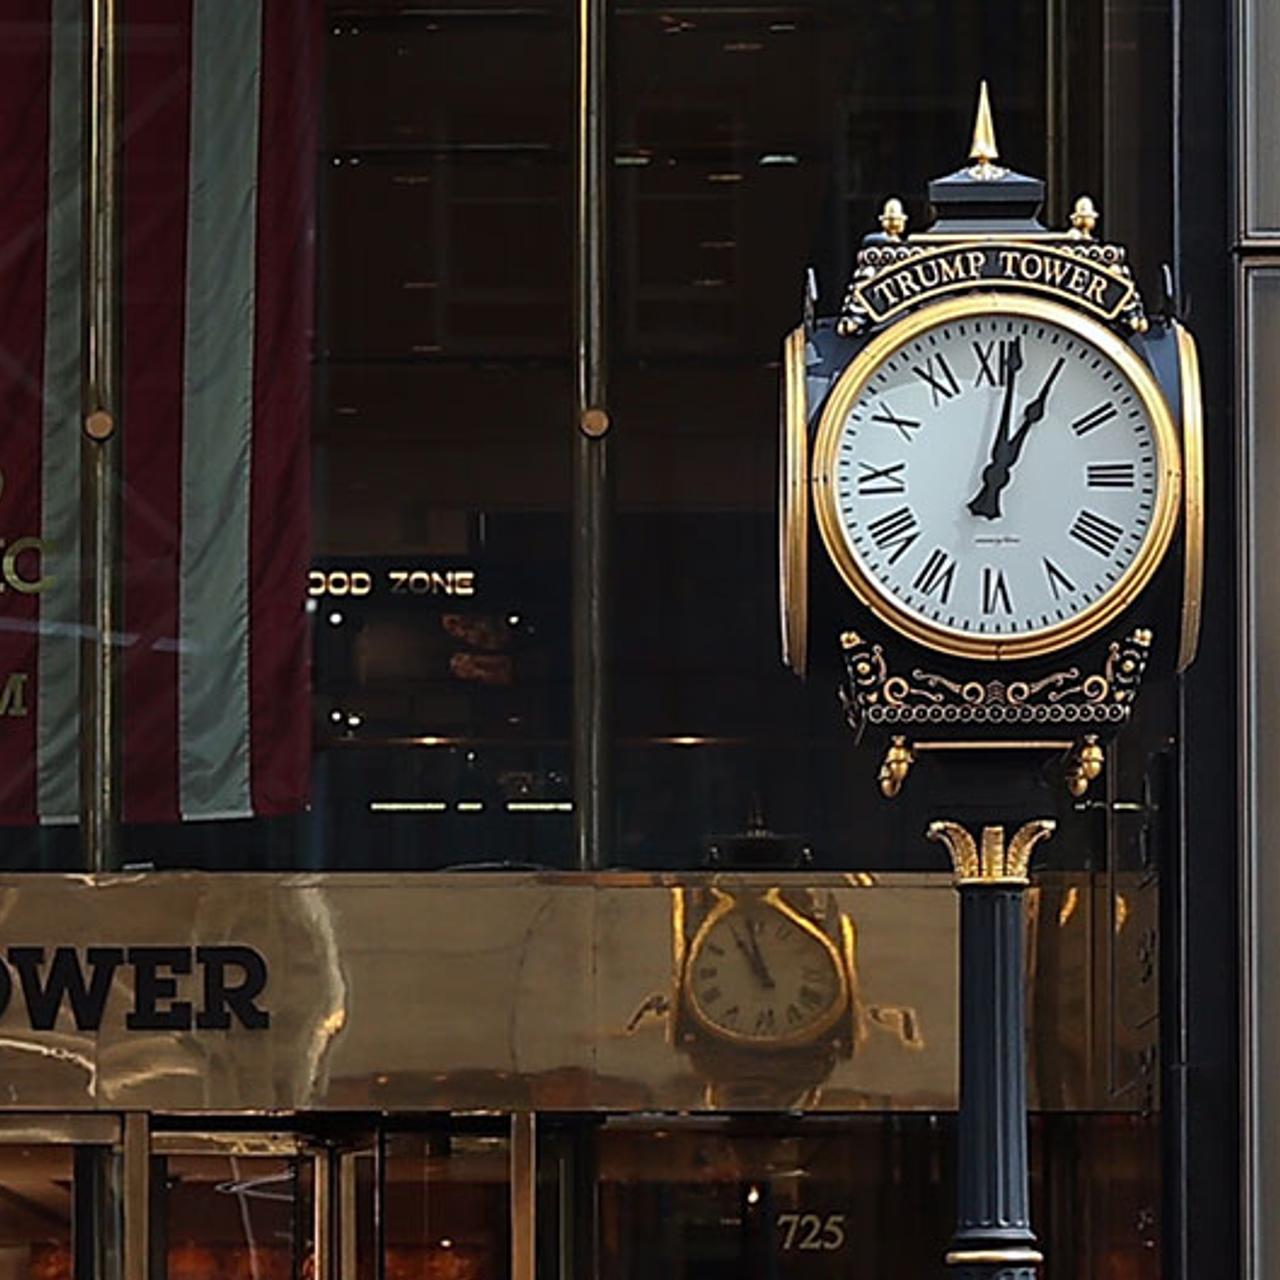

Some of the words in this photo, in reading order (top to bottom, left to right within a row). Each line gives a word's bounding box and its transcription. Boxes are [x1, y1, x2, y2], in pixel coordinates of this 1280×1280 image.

[872, 252, 986, 305] TRUMP
[999, 251, 1108, 304] TOWER
[388, 570, 477, 596] ZONE
[777, 1214, 846, 1251] 725
